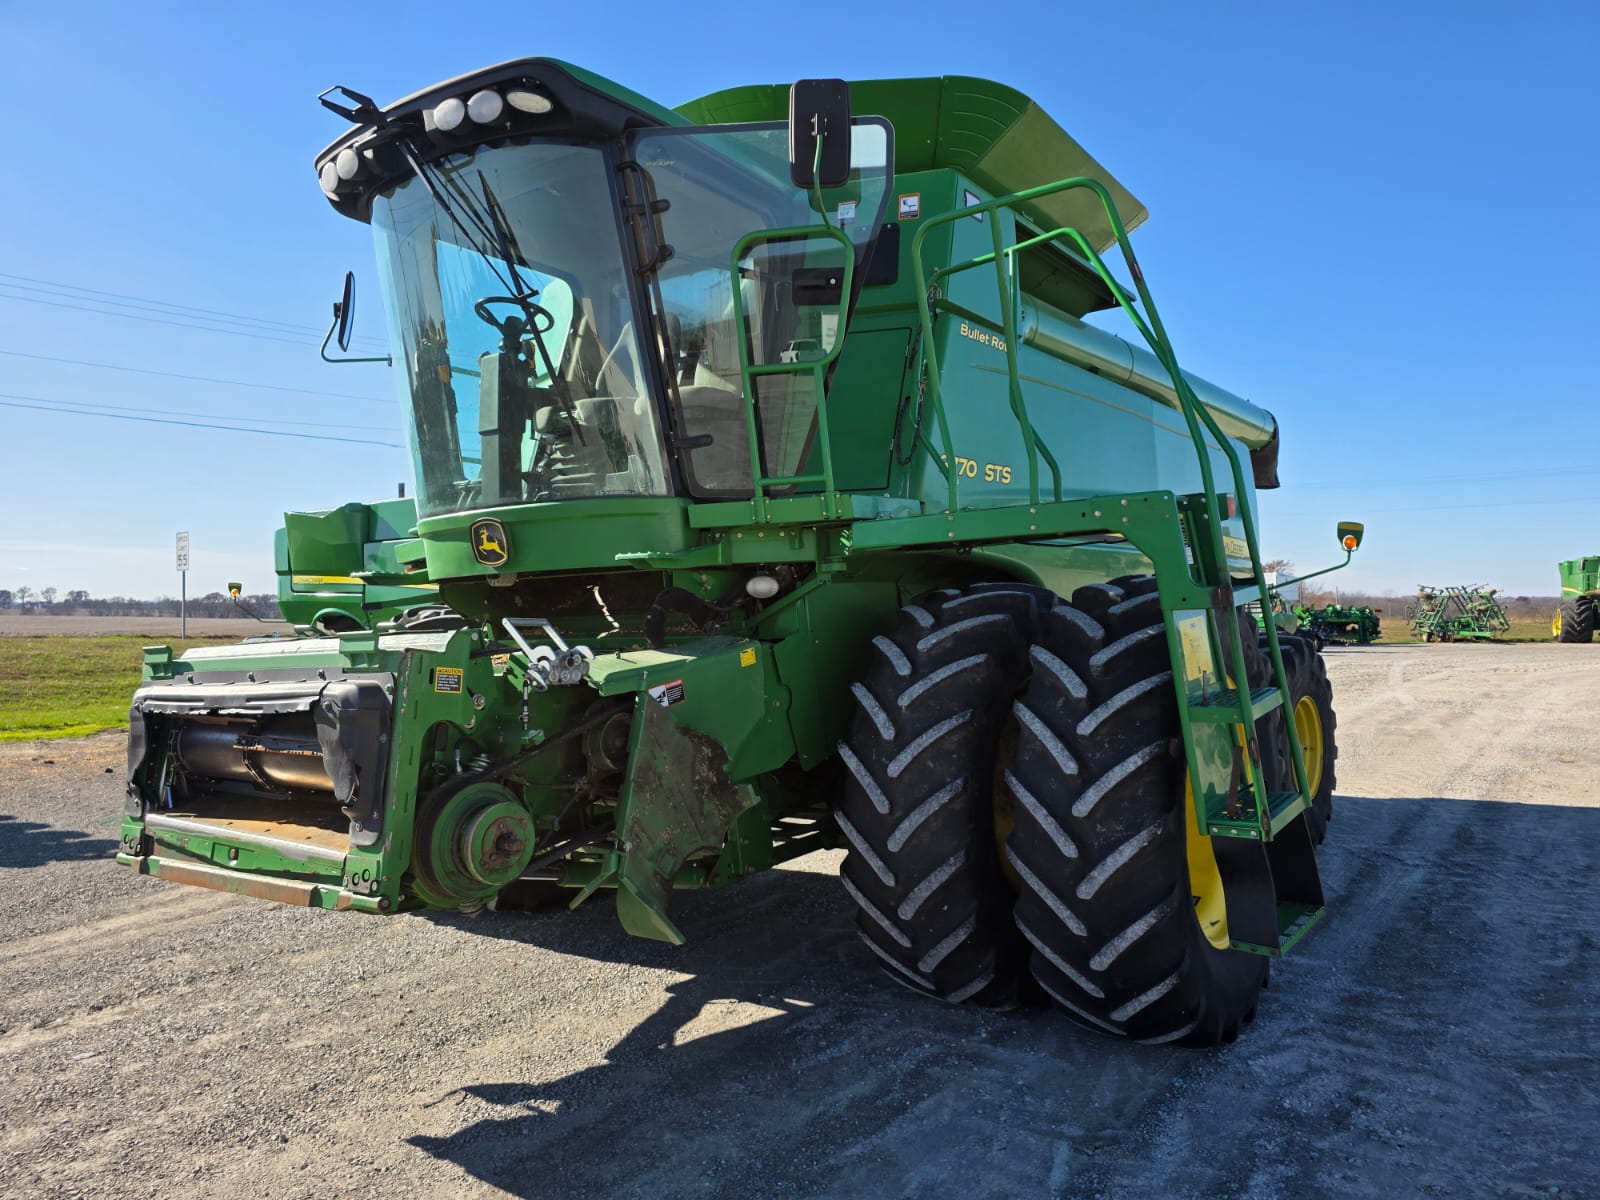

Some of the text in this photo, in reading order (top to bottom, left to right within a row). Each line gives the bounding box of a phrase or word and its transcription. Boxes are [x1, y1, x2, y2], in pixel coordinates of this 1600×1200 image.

[960, 323, 989, 345] Bullet
[984, 463, 1012, 484] STS
[177, 554, 188, 567] 55
